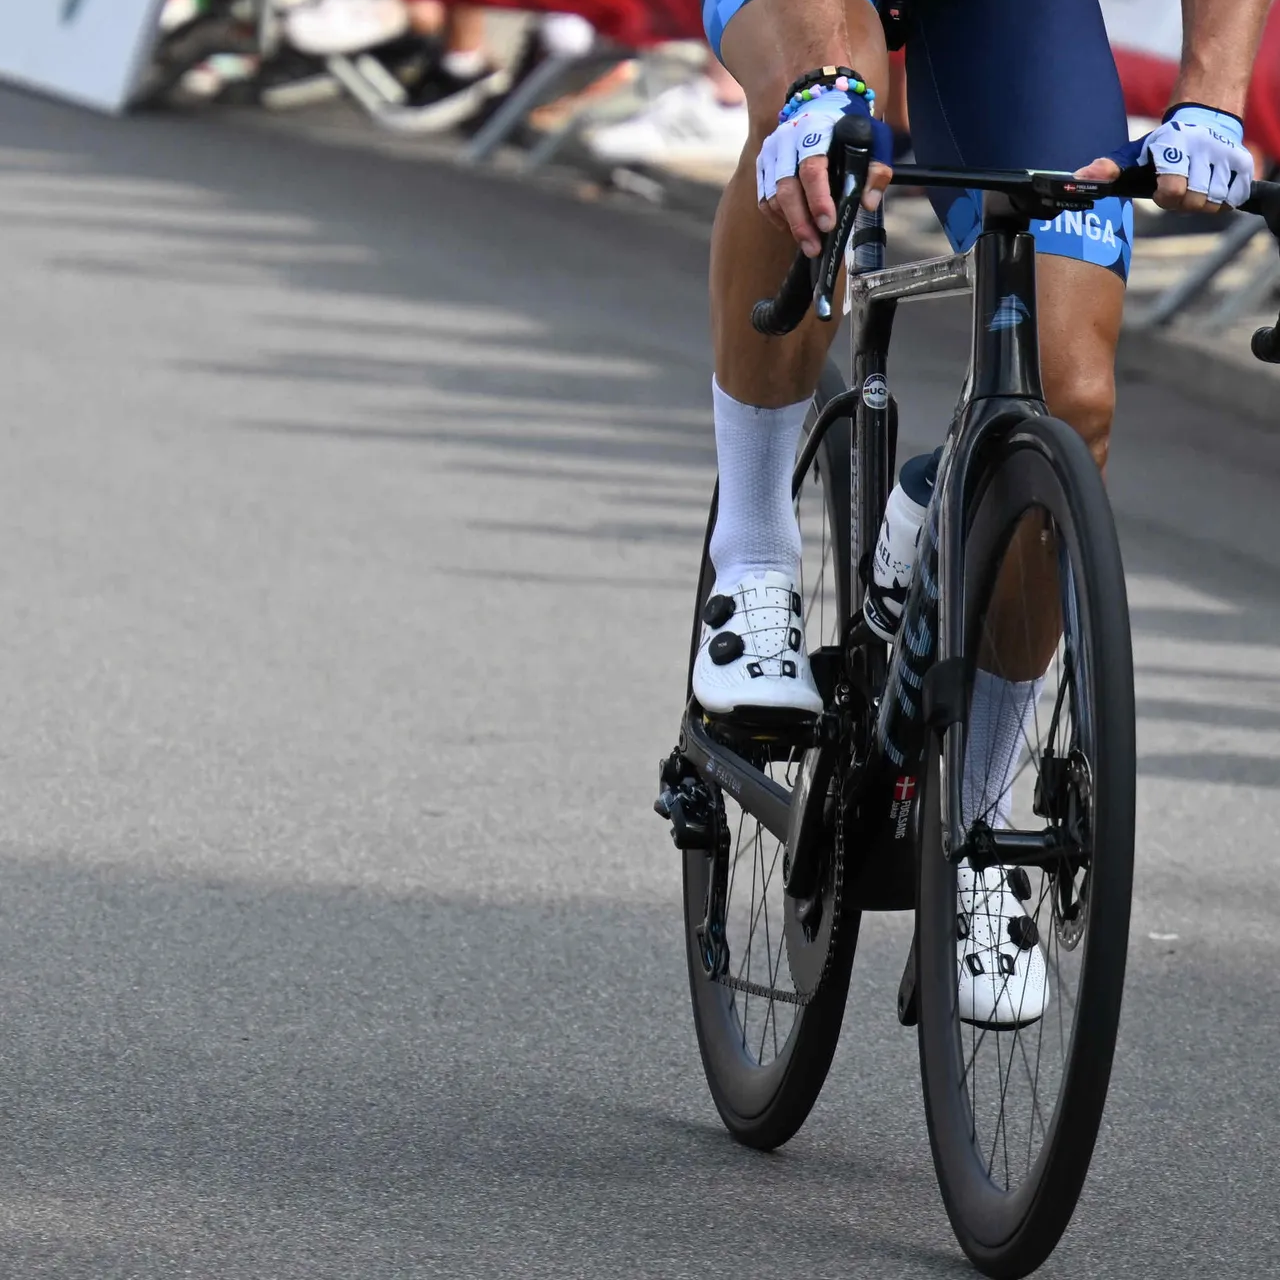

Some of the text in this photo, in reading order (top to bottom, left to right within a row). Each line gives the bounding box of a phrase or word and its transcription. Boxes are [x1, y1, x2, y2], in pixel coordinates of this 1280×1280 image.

[1206, 127, 1236, 149] TECH
[1040, 209, 1116, 248] JINGA
[895, 800, 911, 839] FUGLSANG
